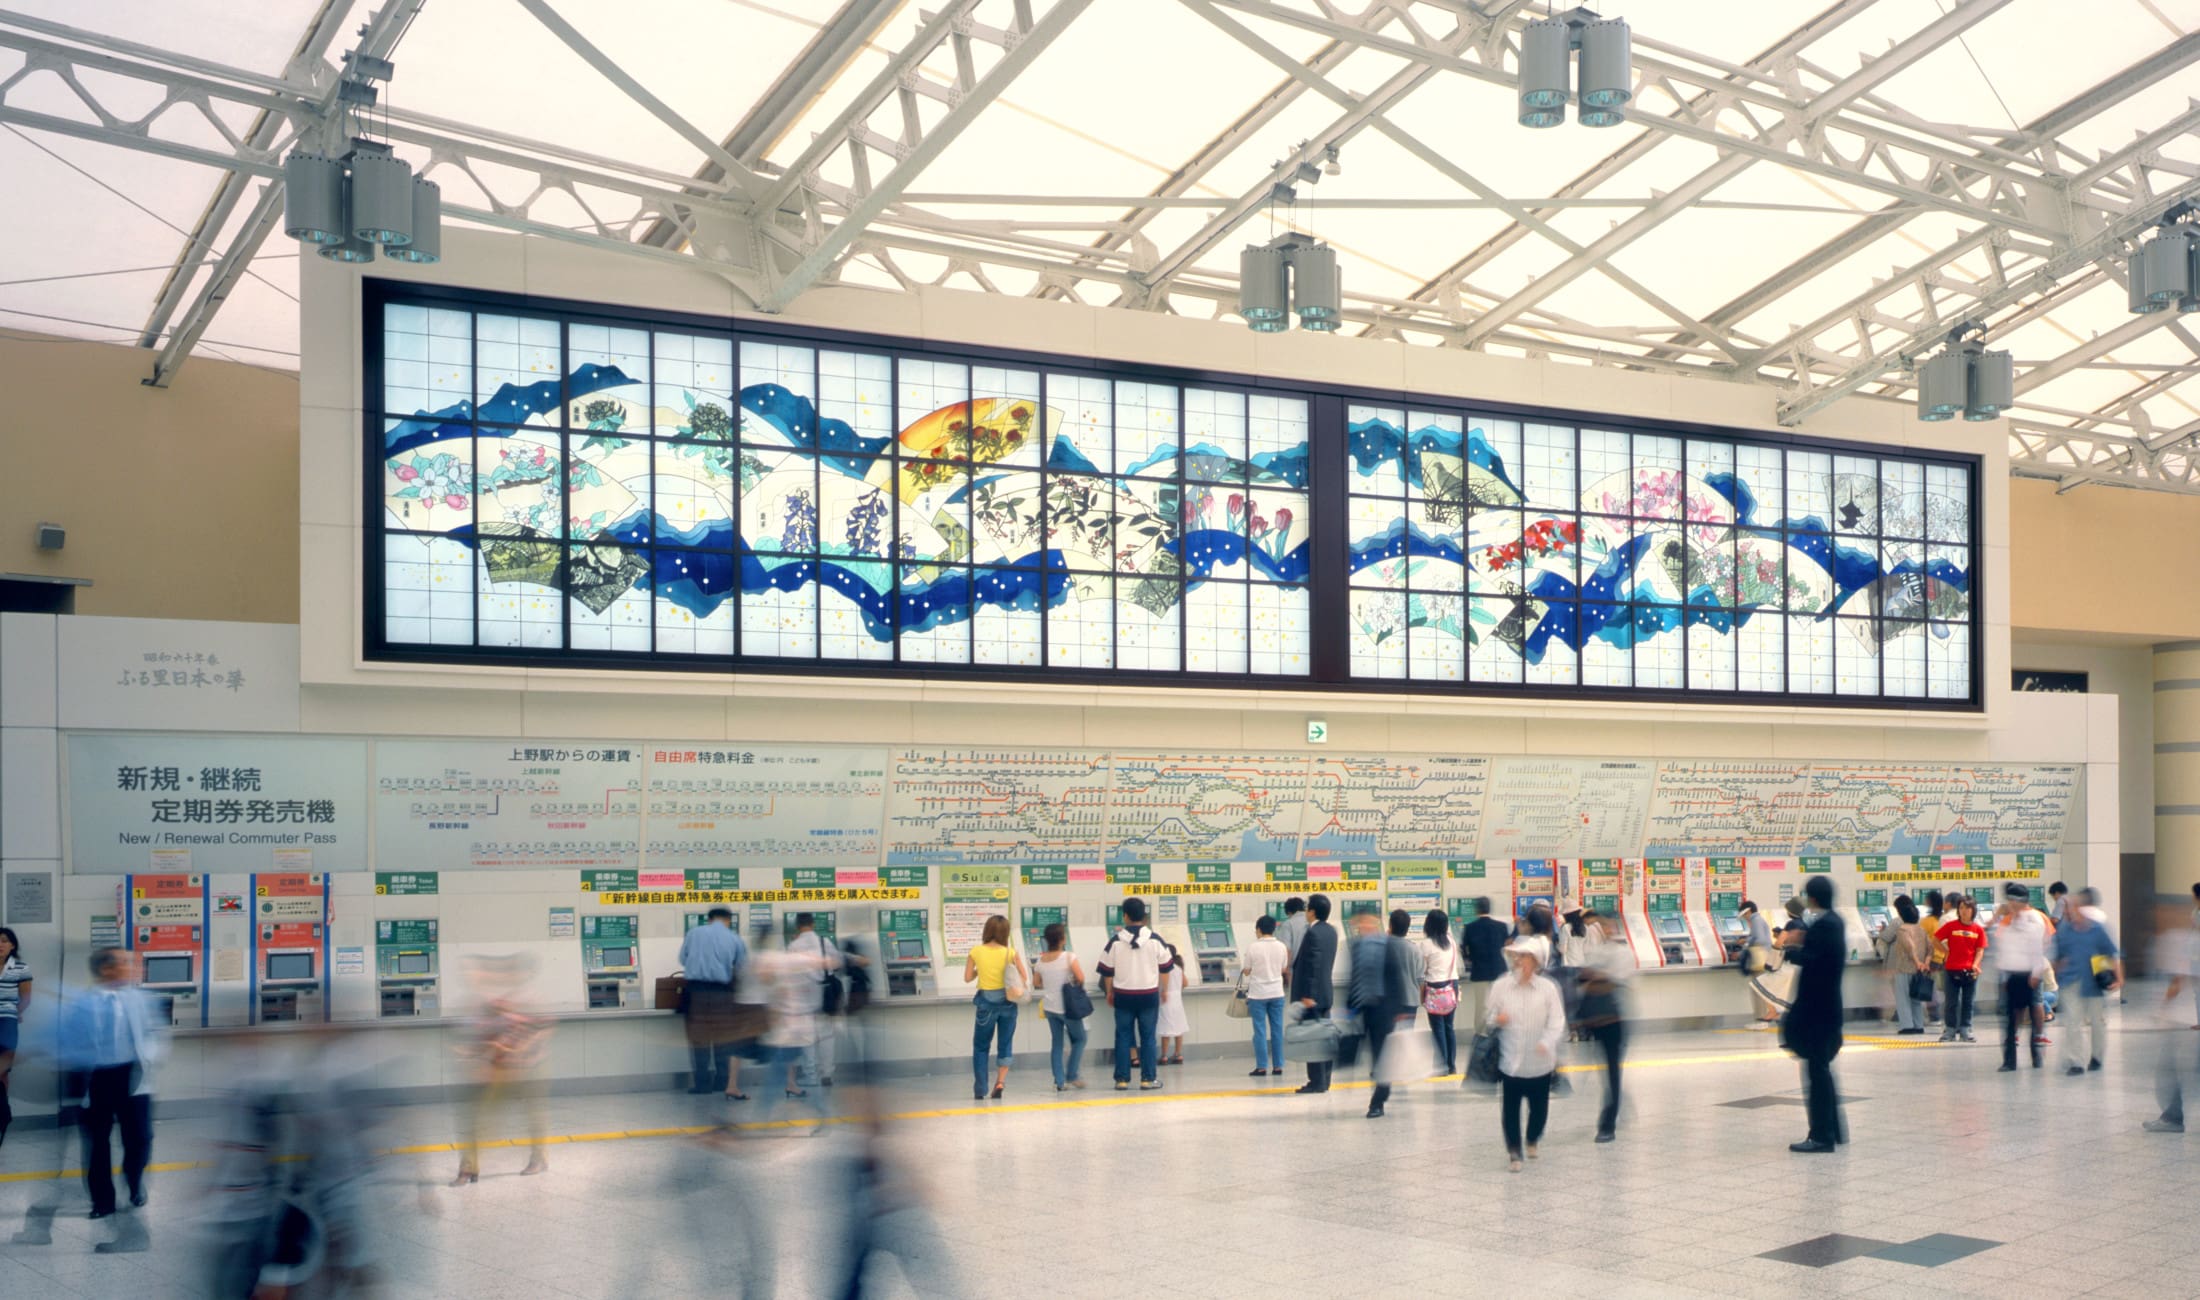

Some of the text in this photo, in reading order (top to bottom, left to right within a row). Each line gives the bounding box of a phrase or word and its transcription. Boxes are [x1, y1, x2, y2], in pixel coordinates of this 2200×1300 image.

[117, 668, 246, 692] ふる里日本の華
[654, 751, 755, 765] 自由席特急料金
[117, 766, 262, 792] 新規・継続
[151, 799, 336, 824] 定期券発売機
[119, 832, 337, 845] New / Renewal Commuter Pass
[962, 873, 1000, 881] Suica
